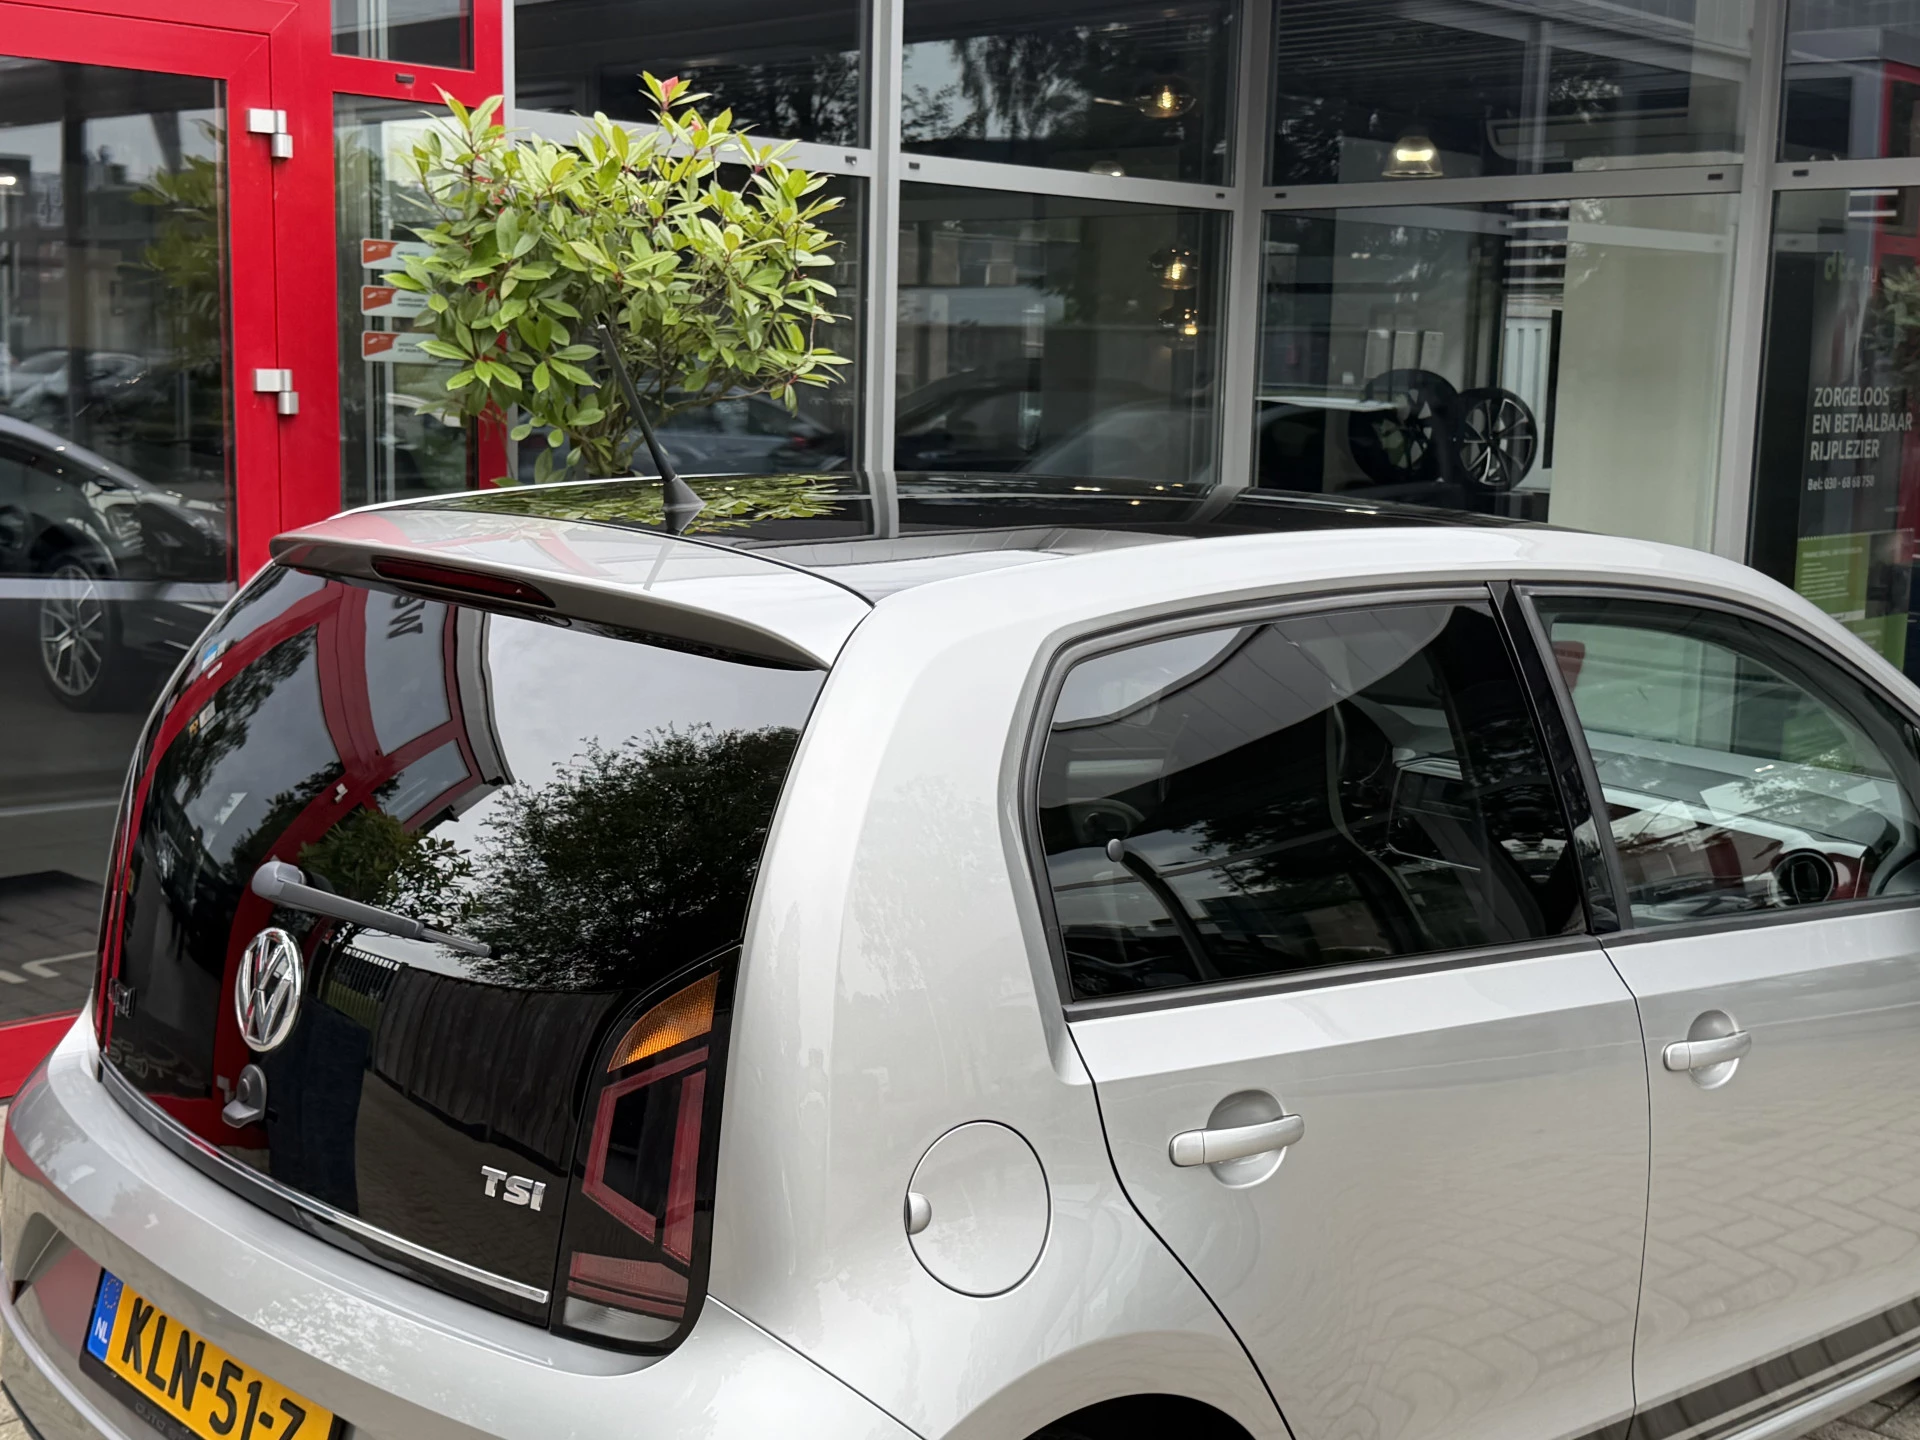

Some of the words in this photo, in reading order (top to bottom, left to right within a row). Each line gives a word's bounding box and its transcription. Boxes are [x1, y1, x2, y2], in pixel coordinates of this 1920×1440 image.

[1814, 387, 1889, 407] ZORGELOOS
[1812, 414, 1831, 434] EN
[1834, 411, 1913, 433] BETAALBAAR
[1810, 438, 1880, 461] RIJPLEZIER
[1807, 477, 1823, 491] Bel:
[481, 1165, 546, 1211] TSI
[94, 1317, 108, 1344] NL
